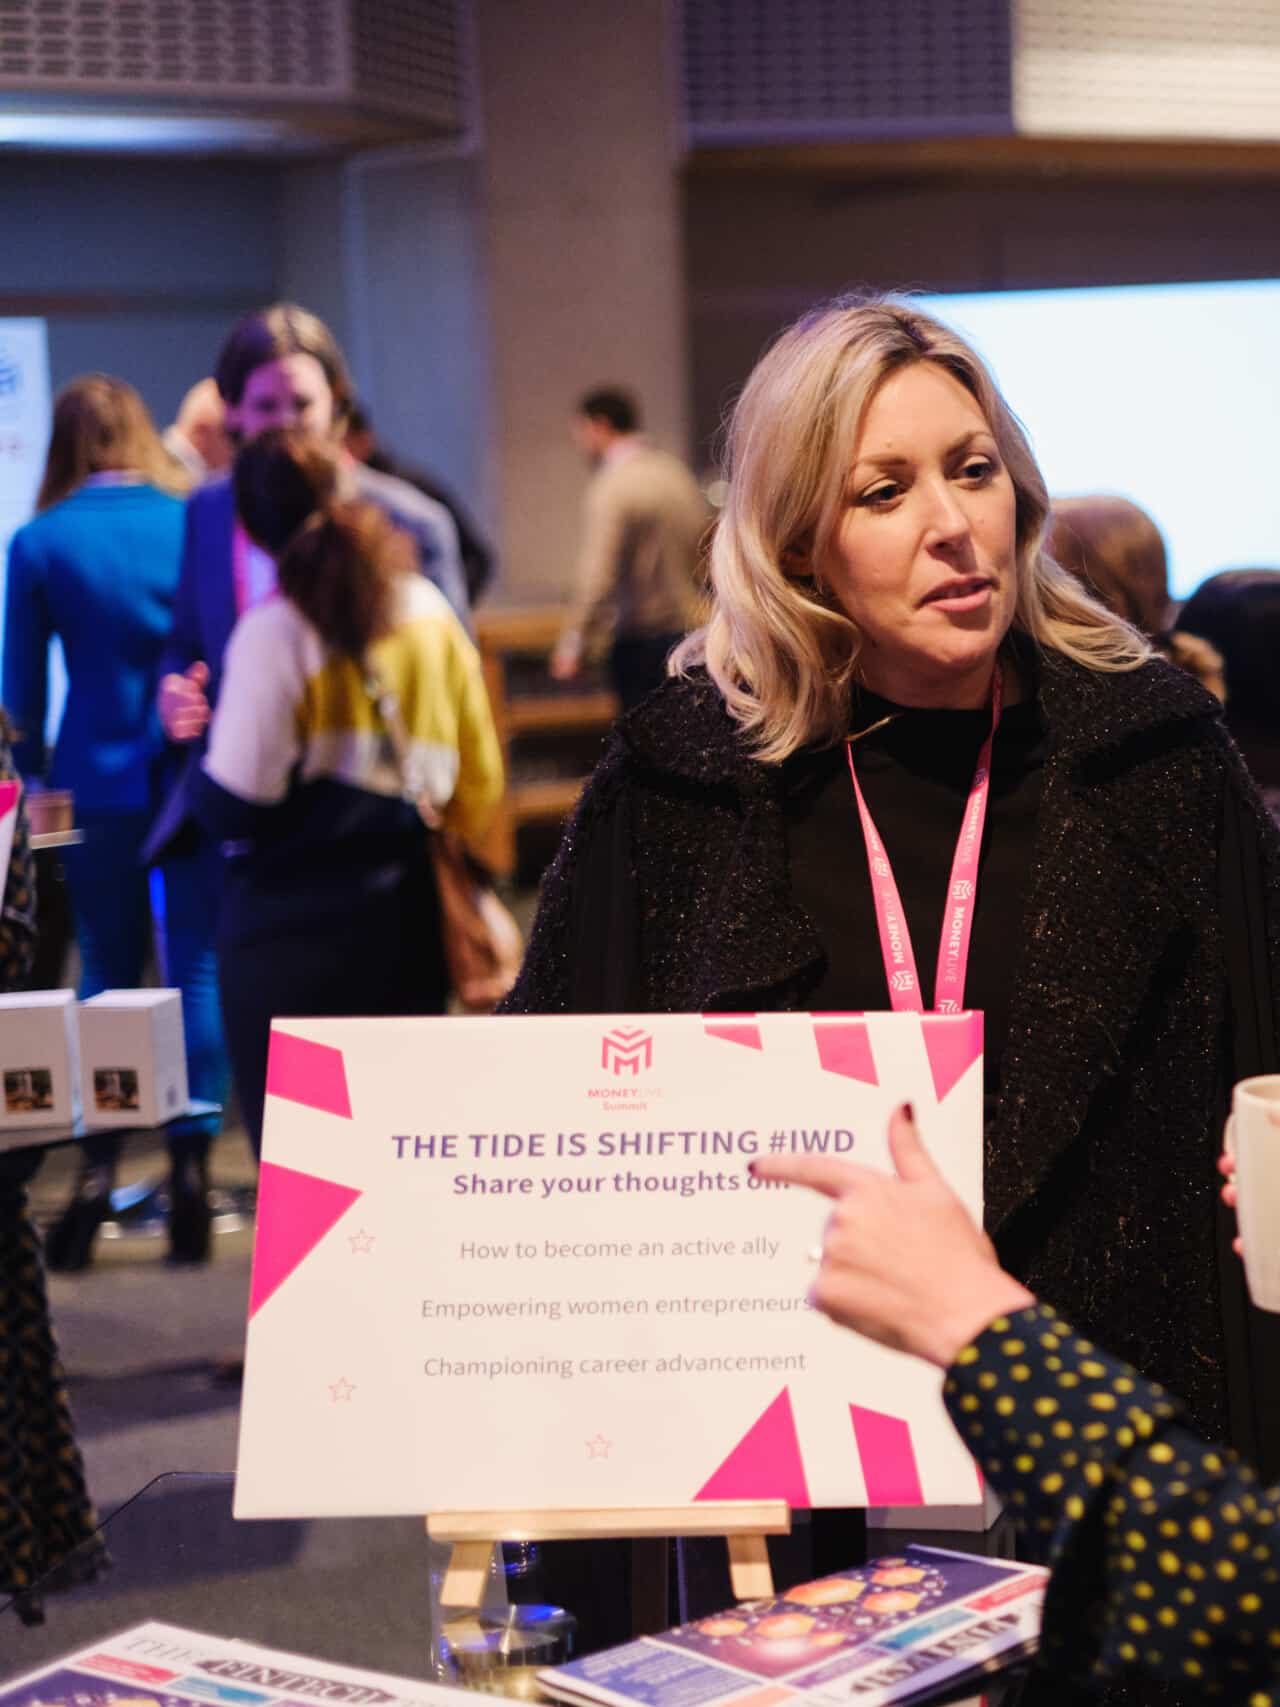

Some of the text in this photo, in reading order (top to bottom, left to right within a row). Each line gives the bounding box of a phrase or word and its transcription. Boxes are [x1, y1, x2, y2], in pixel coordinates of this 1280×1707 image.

[391, 1129, 855, 1159] THE TIDE IS SHIFTING #IWD
[453, 1173, 533, 1195] Share
[541, 1176, 606, 1199] your
[612, 1169, 740, 1197] thoughts
[460, 1236, 780, 1259] How to become an active ally
[420, 1297, 562, 1320] Empowering
[567, 1300, 649, 1314] women
[423, 1353, 808, 1380] Championing career advancement
